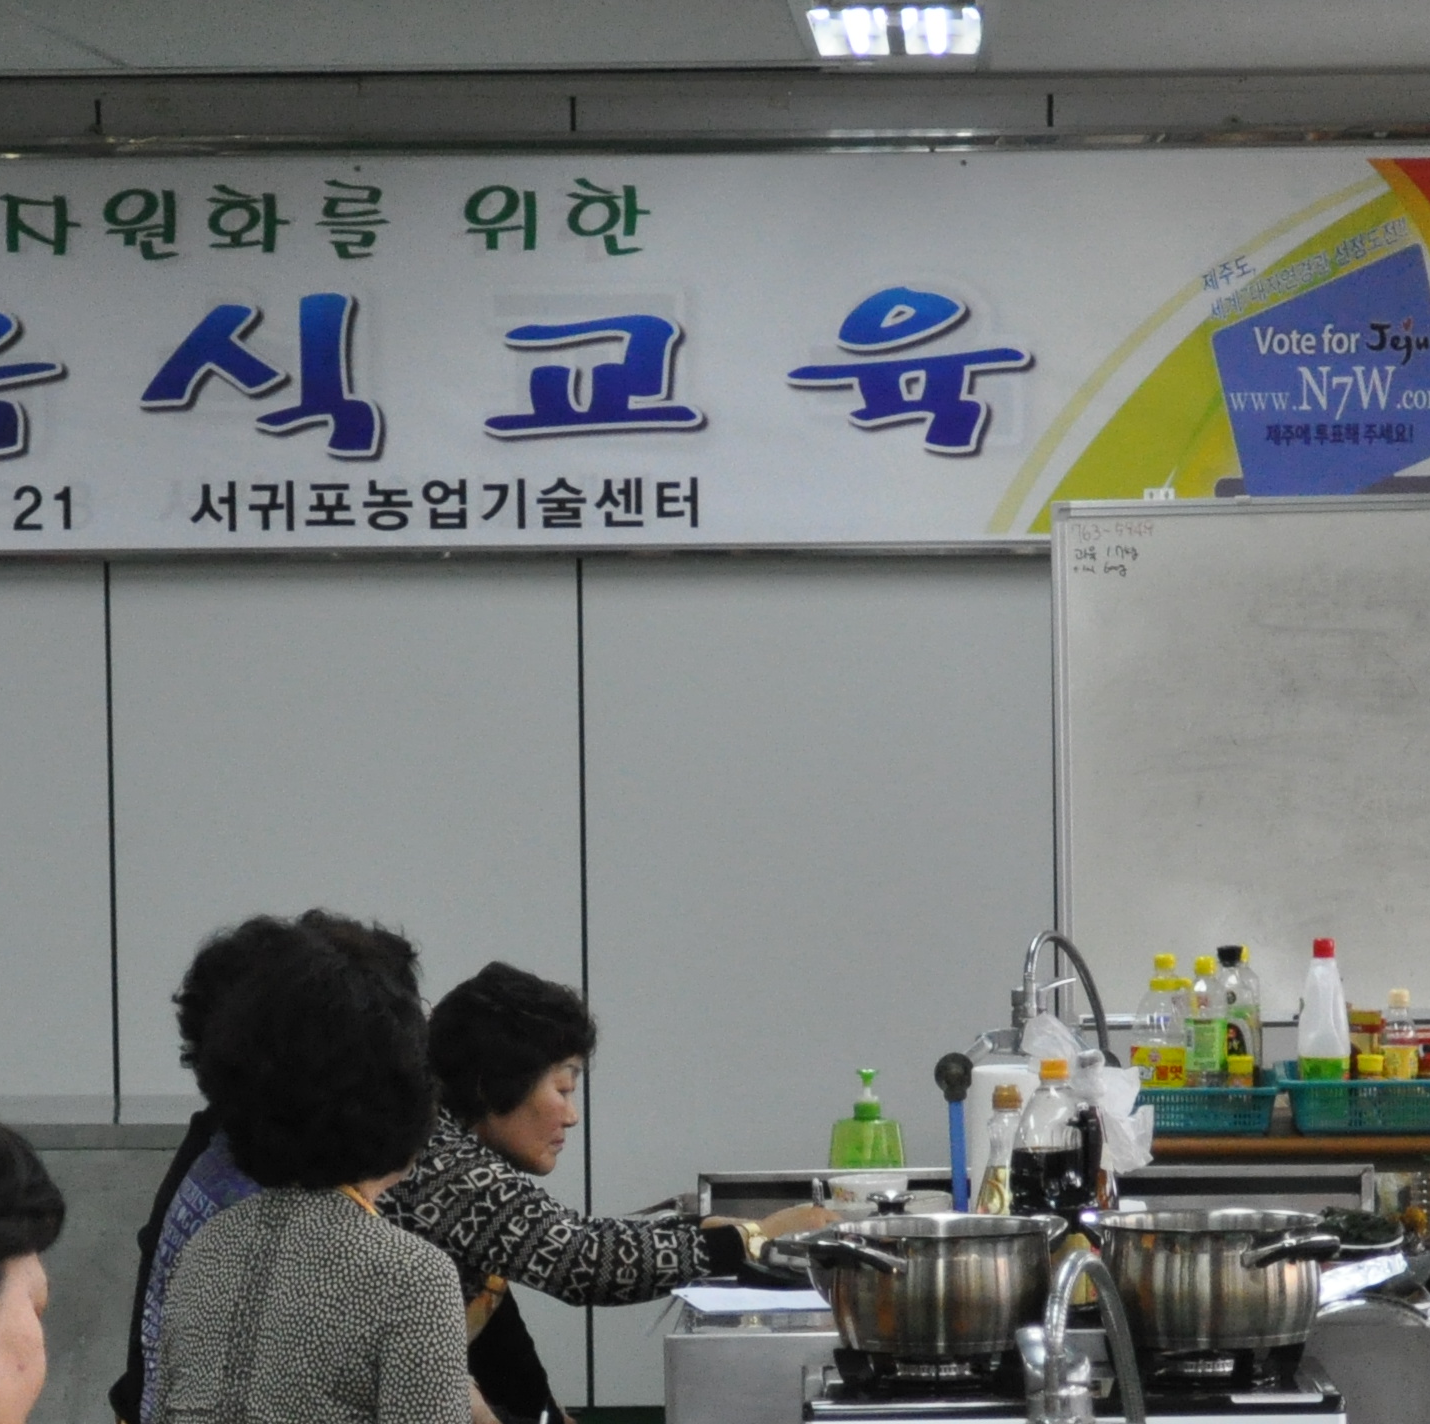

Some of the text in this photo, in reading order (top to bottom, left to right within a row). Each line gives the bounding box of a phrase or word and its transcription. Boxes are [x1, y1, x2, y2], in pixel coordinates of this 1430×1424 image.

[0, 178, 388, 261] 자원화를
[464, 178, 651, 258] 위한
[1254, 317, 1430, 365] Vote for Jeju
[13, 485, 74, 531] 21
[190, 477, 701, 532] 서귀포농업기술센터
